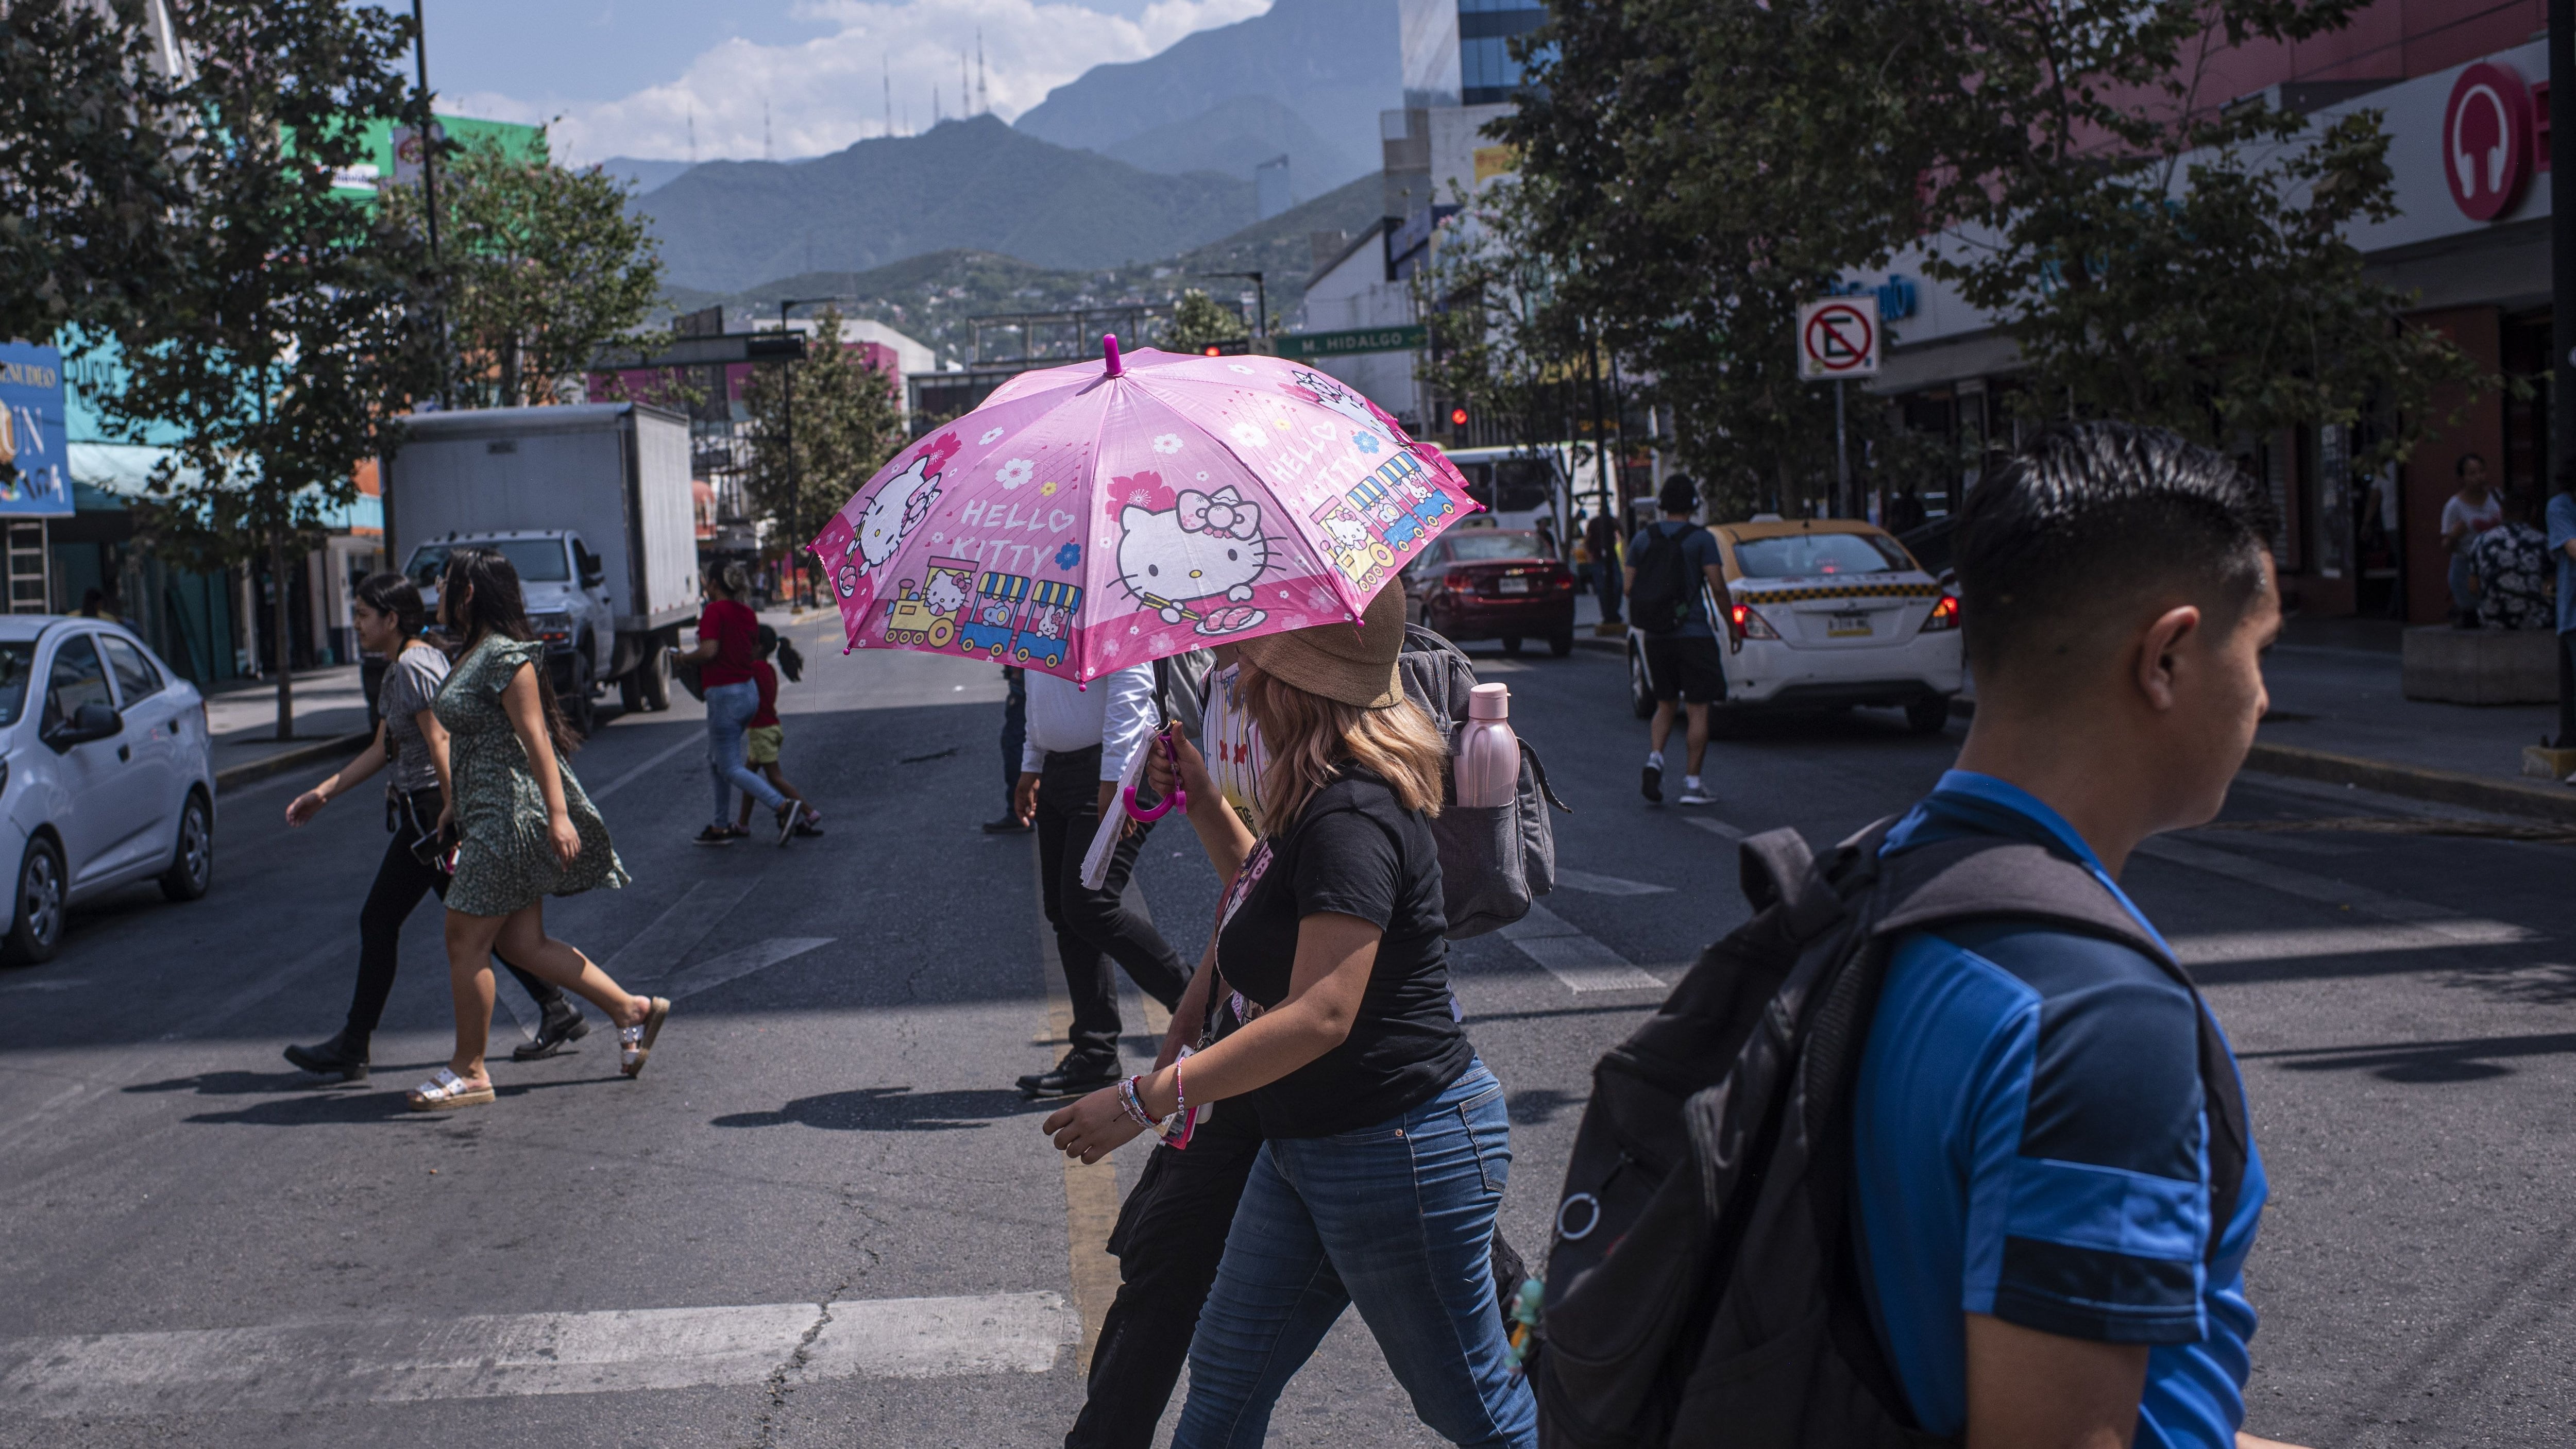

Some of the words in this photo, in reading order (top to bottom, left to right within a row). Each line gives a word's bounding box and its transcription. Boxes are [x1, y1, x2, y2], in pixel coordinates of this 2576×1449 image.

[1302, 340, 1320, 352] M.
[1326, 332, 1402, 351] HIDALGO
[1300, 447, 1368, 508] KITTY
[950, 536, 1054, 576] KITTY
